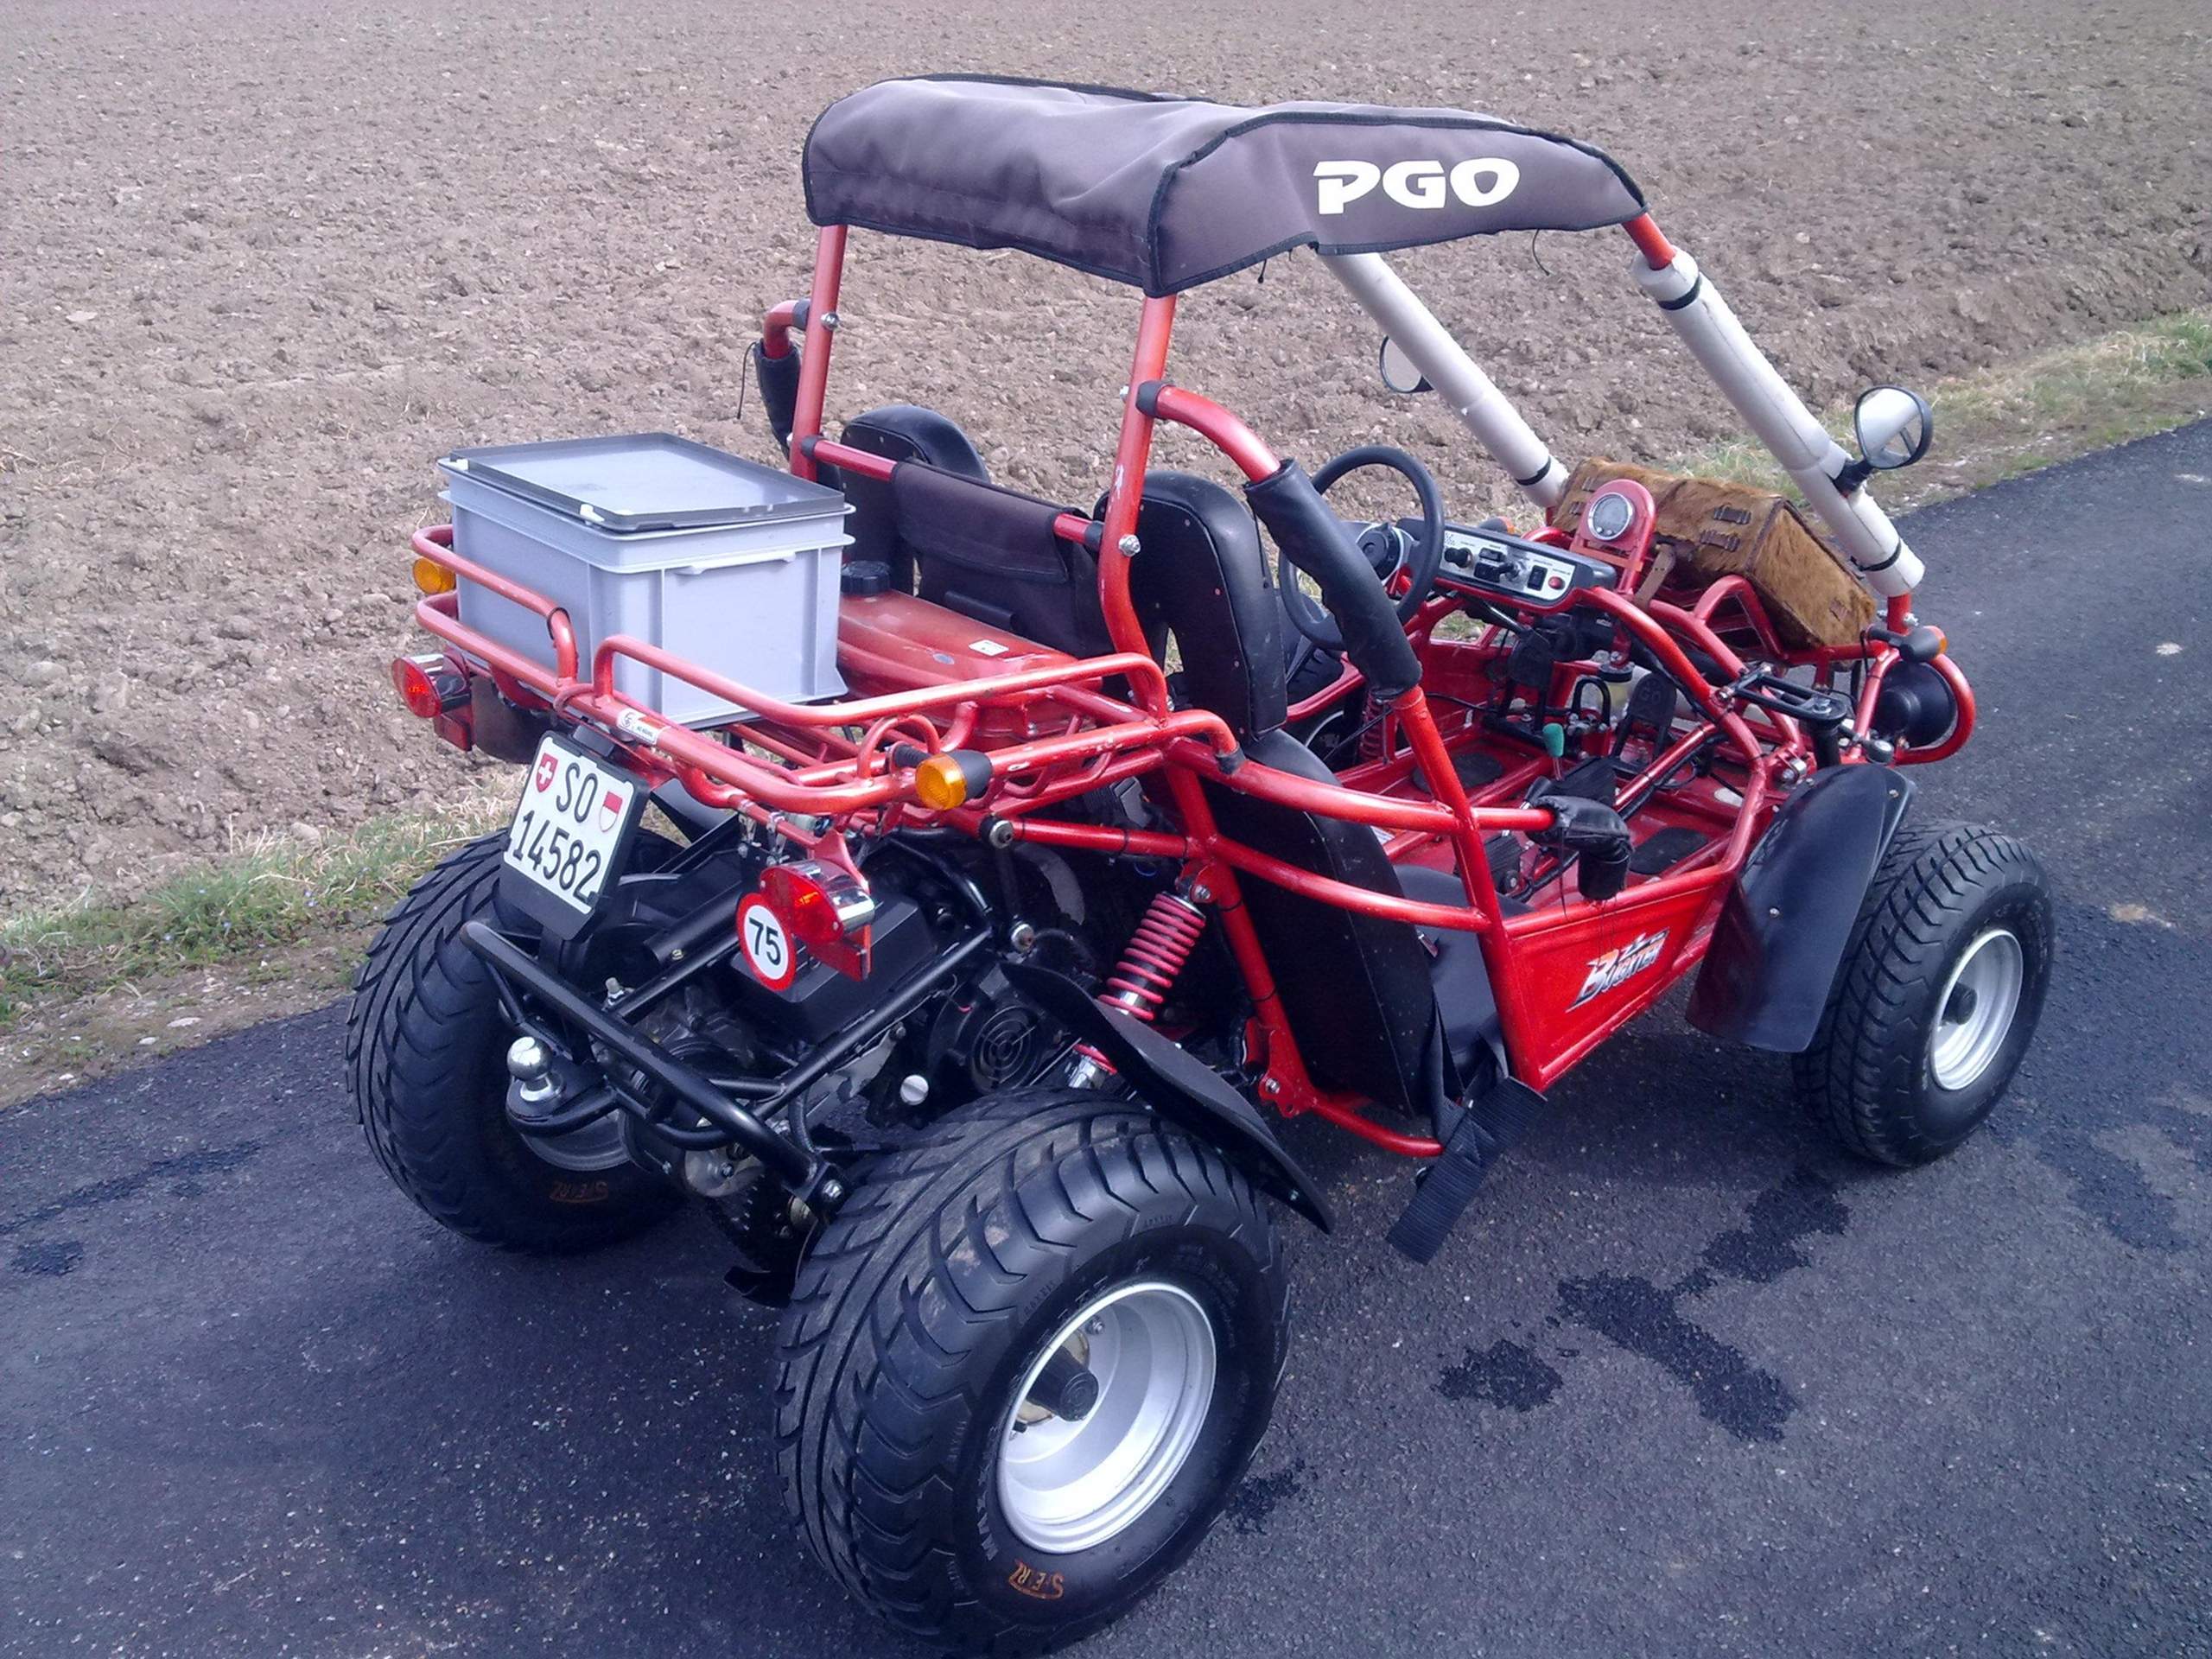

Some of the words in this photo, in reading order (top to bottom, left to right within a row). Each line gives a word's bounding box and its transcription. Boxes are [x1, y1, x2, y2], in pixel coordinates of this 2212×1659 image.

[1313, 157, 1521, 215] PGO
[556, 762, 599, 823] SO
[512, 810, 602, 905] 14582
[748, 917, 782, 966] 75
